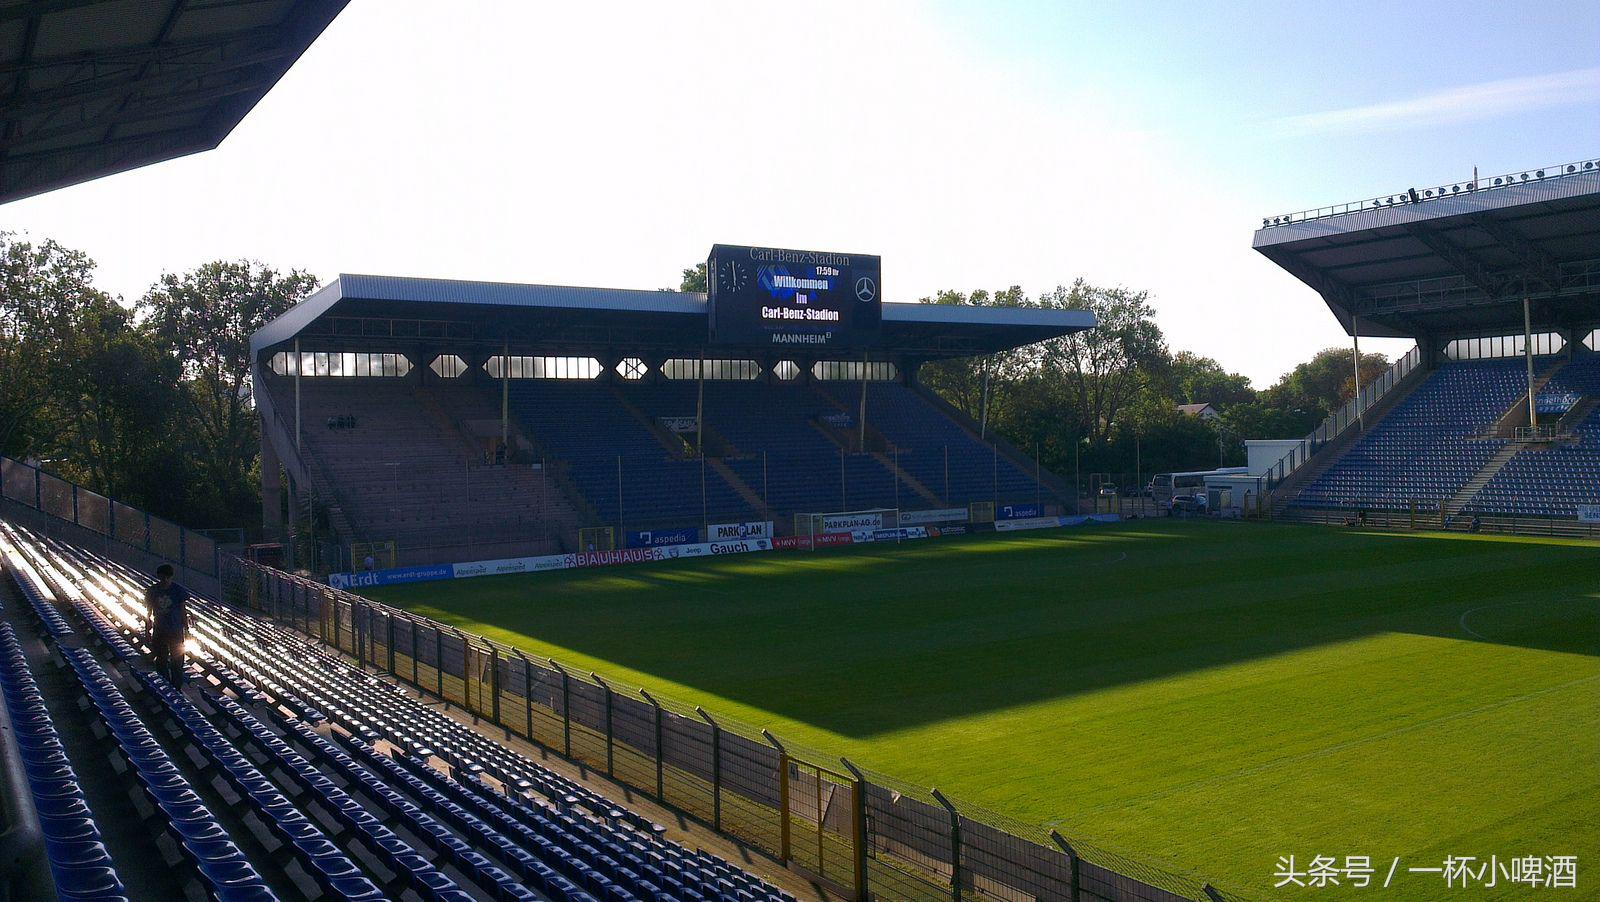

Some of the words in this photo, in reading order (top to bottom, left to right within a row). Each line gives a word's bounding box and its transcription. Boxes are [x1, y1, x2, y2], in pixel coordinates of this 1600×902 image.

[750, 247, 850, 266] Carl-Benz-Stadion
[816, 266, 832, 276] 17:59
[774, 275, 828, 290] Willkommen
[762, 306, 839, 321] Carl-Benz-Stadion
[718, 524, 762, 538] PARKPLAN
[654, 534, 686, 545] aspedia
[710, 541, 749, 555] Gauch
[577, 548, 653, 567] BAUHAUS
[350, 571, 380, 587] Erdt
